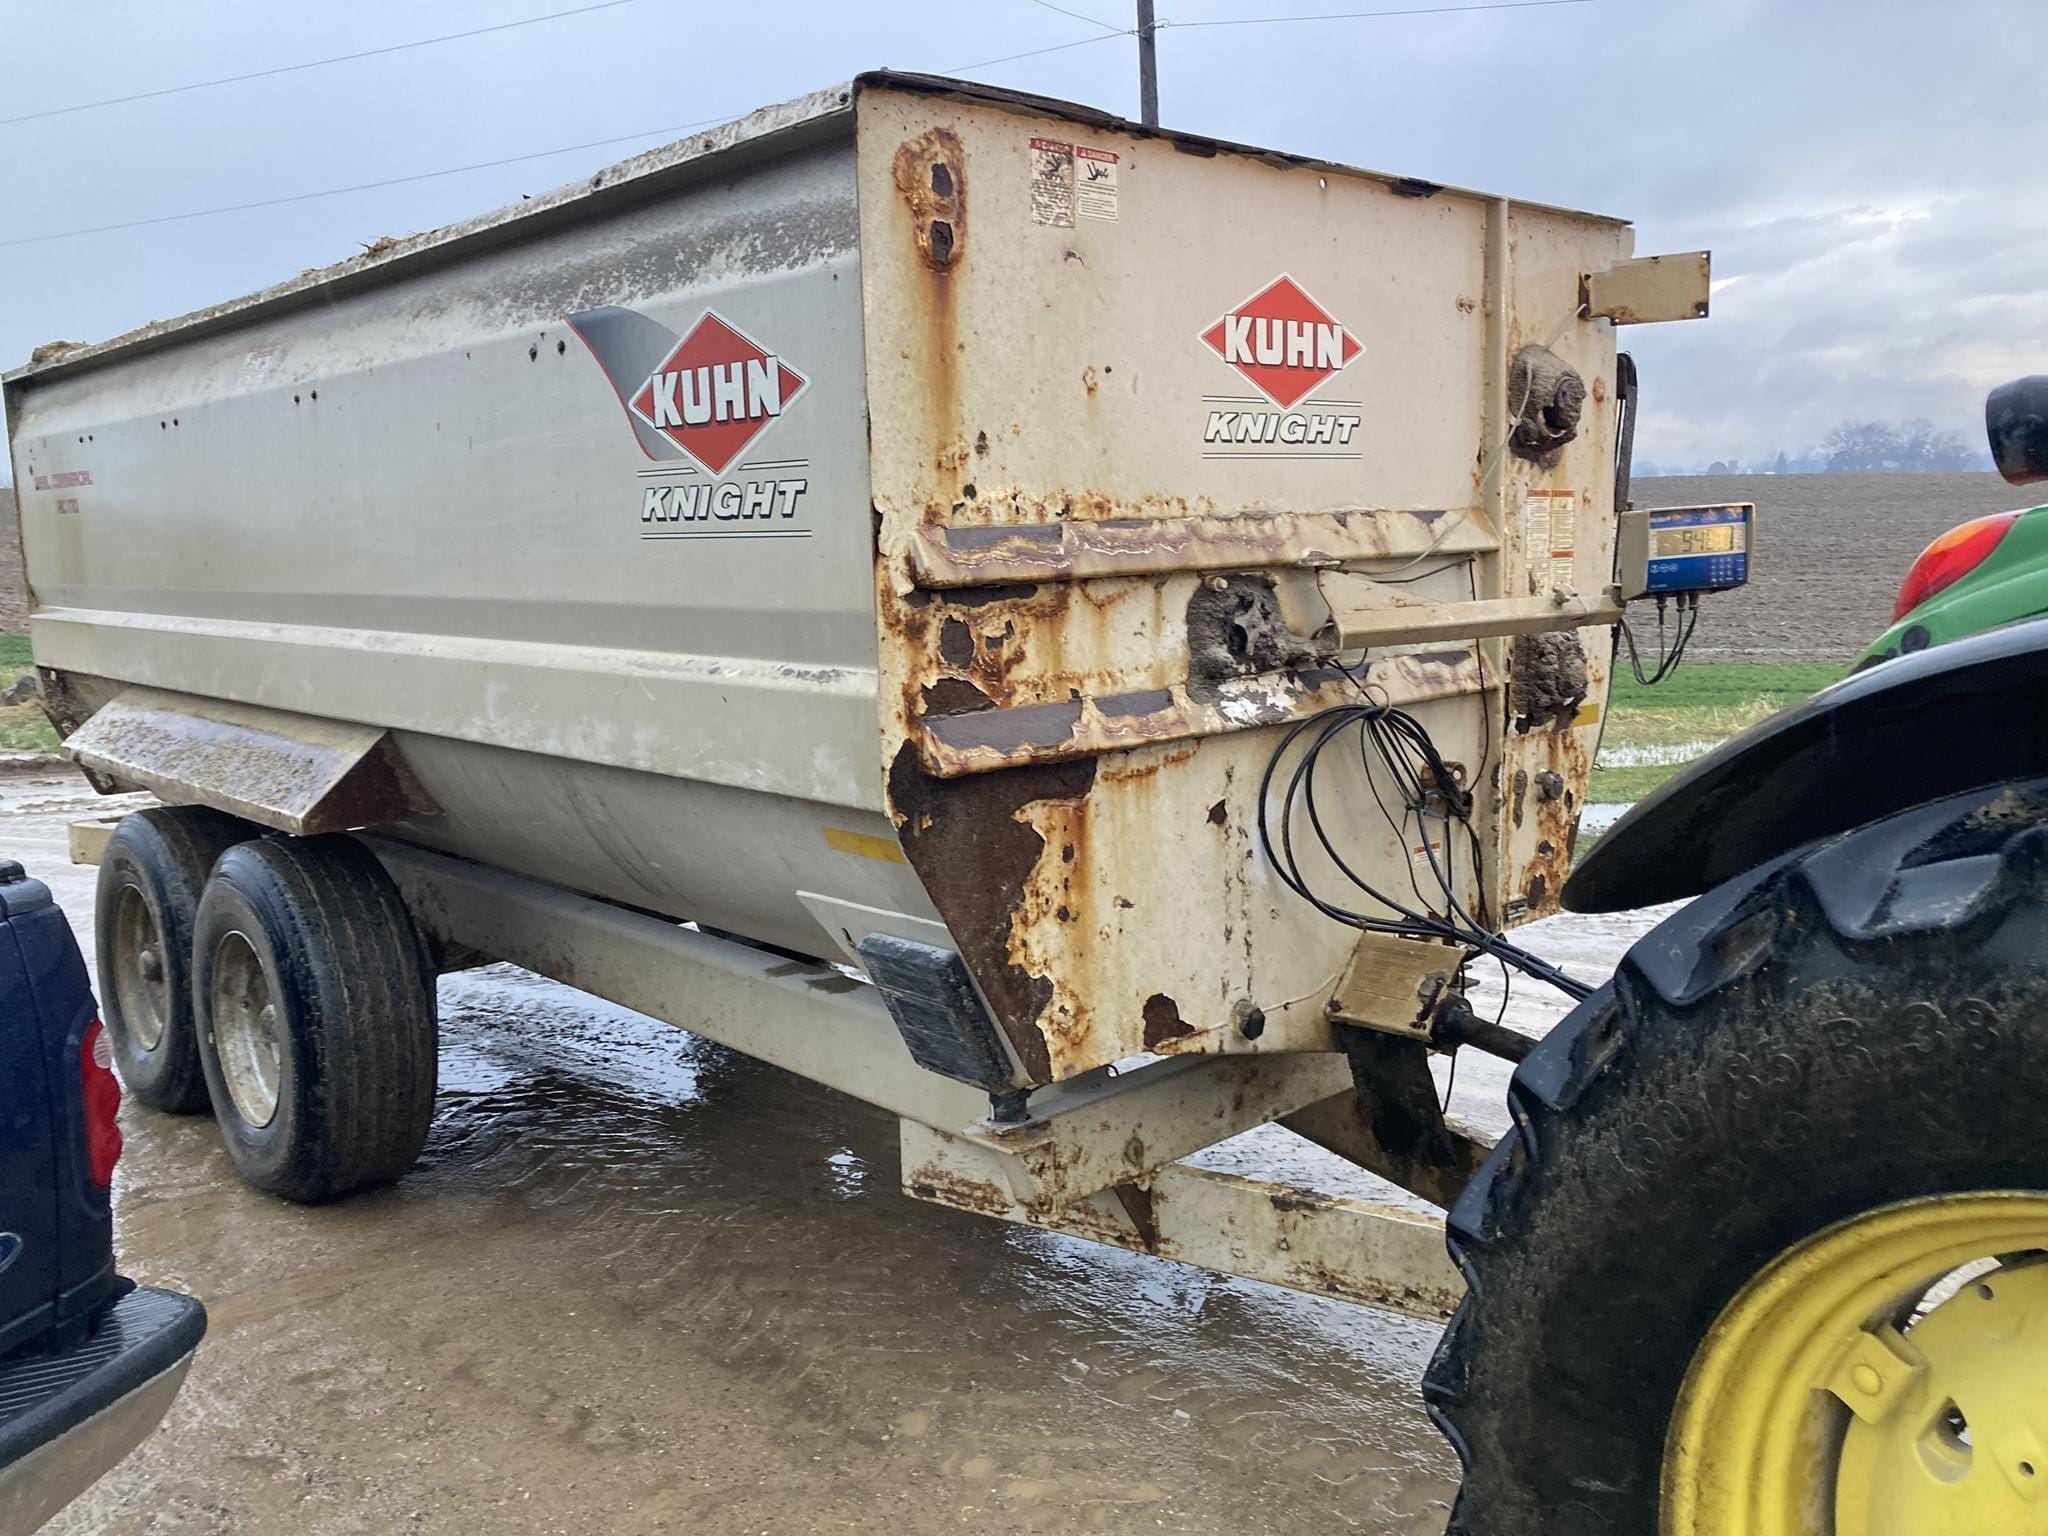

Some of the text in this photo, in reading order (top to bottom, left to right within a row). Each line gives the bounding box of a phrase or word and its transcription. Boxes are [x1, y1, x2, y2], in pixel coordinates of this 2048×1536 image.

[1224, 314, 1343, 371] KUHN
[652, 355, 781, 430] KUHN
[1203, 411, 1361, 445] KNIGHT
[641, 478, 808, 522] KNIGHT
